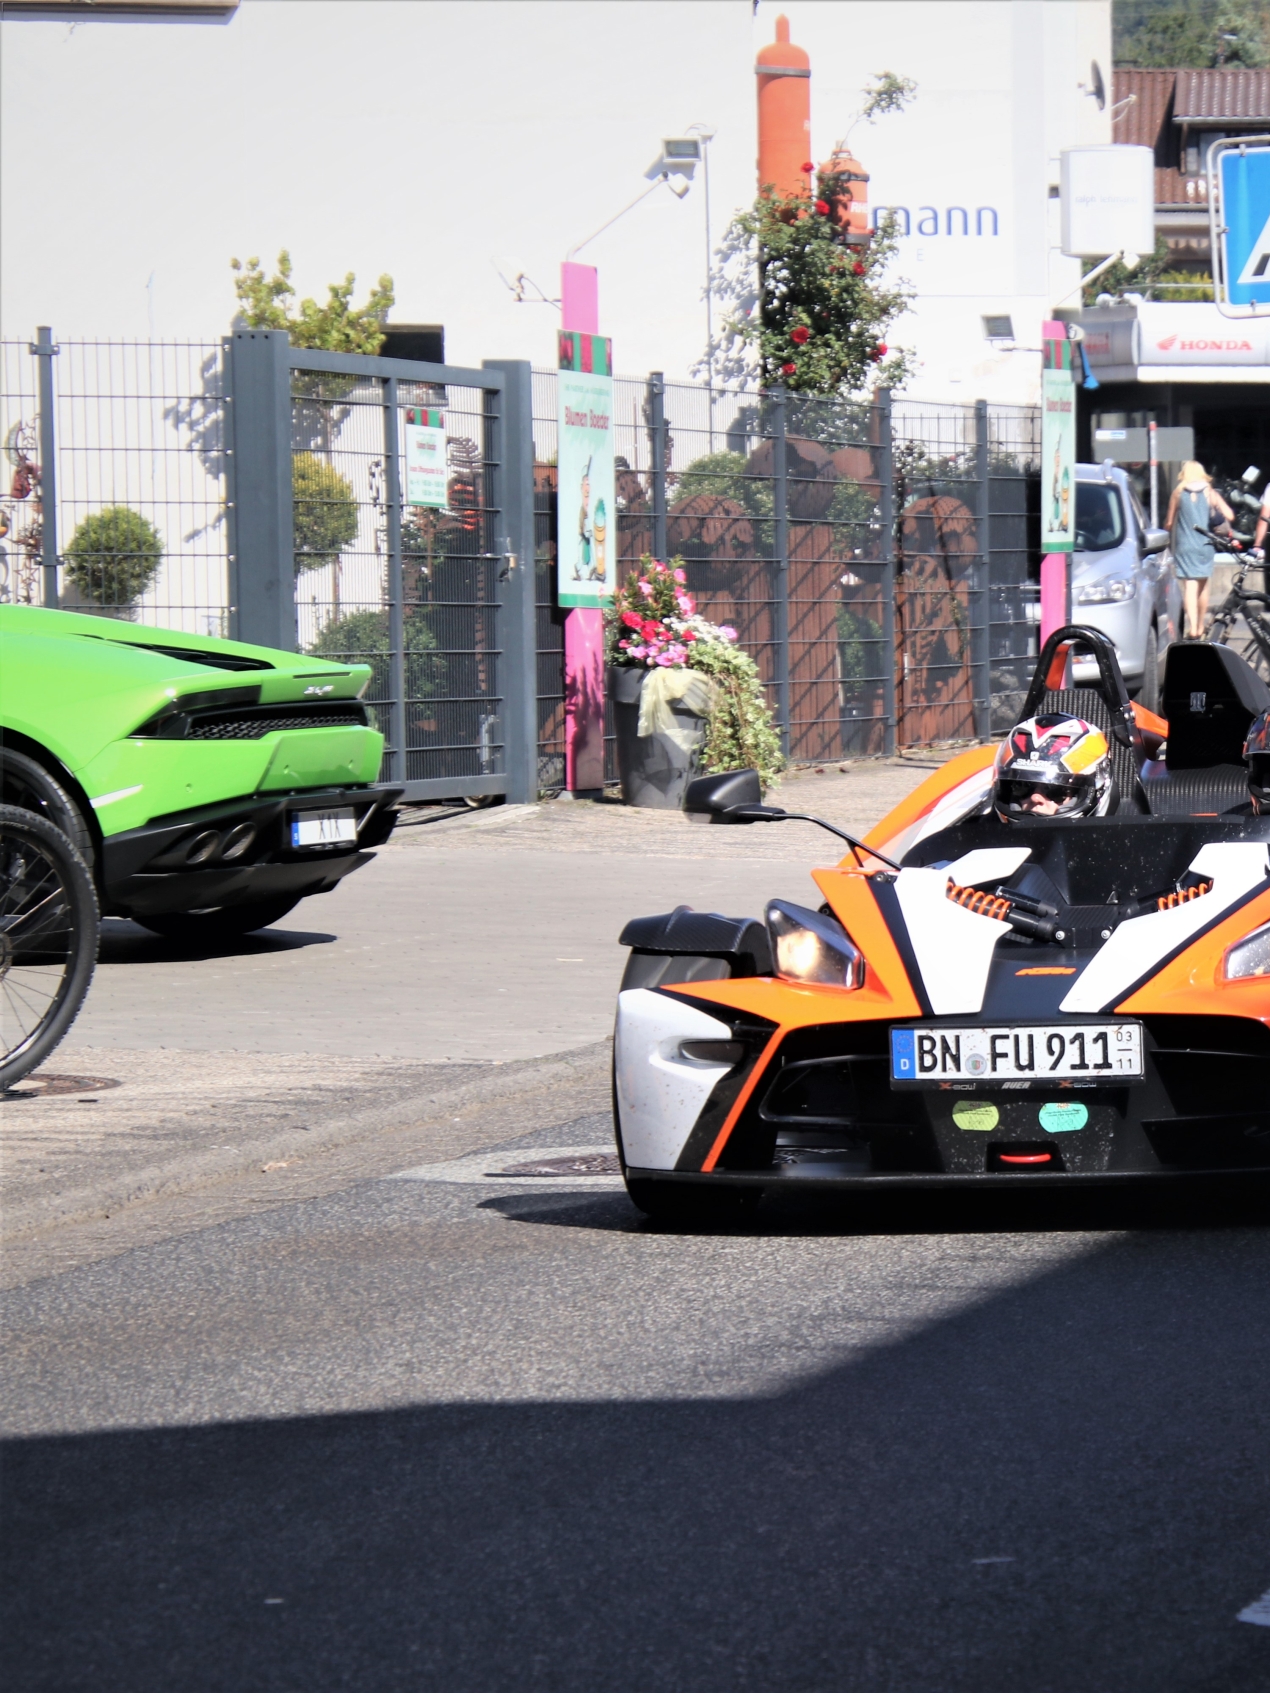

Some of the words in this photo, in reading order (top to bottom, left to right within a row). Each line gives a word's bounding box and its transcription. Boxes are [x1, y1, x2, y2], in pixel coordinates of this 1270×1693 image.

[872, 205, 999, 236] mann
[1180, 339, 1252, 351] HONDA
[1016, 758, 1054, 769] SHARK
[1116, 1031, 1133, 1042] 03
[900, 1058, 910, 1070] D
[917, 1034, 962, 1073] BN
[990, 1033, 1035, 1073] FU
[1045, 1031, 1113, 1071] 911
[1118, 1058, 1134, 1070] 11
